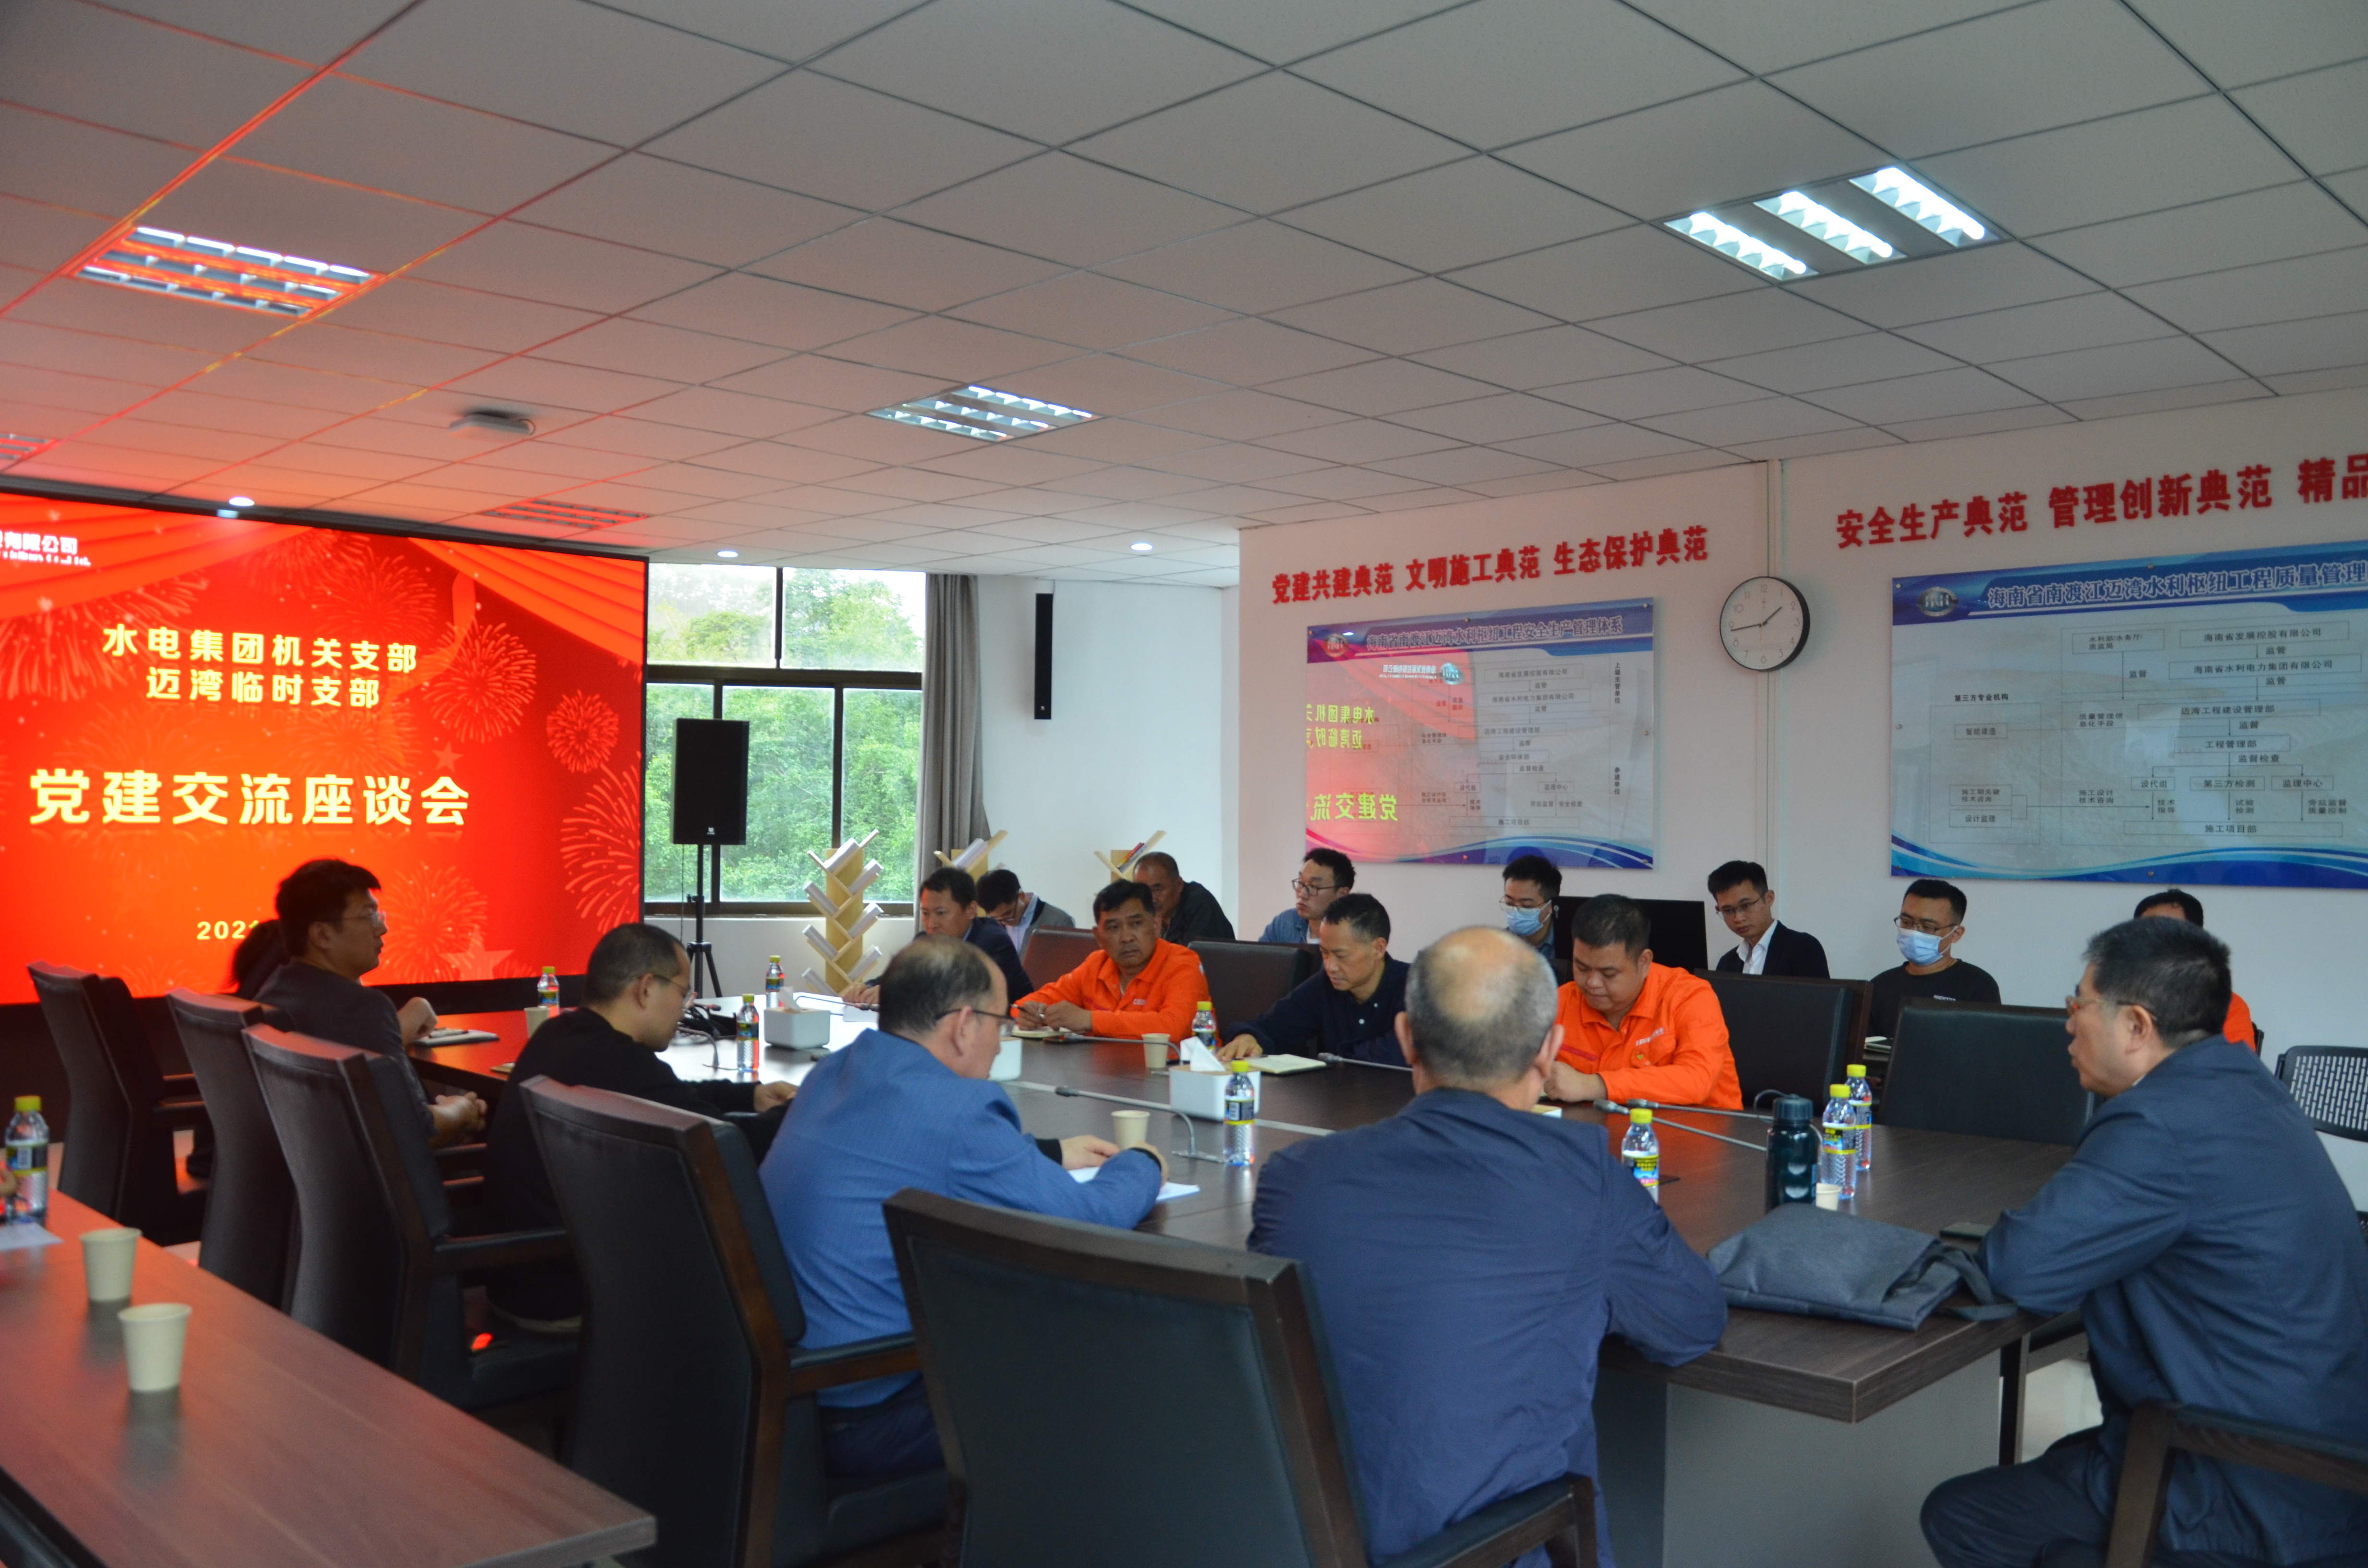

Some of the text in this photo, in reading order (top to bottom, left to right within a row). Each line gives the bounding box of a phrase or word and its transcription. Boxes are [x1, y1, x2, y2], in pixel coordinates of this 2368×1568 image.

[1837, 453, 2368, 549] 安全生产典范 管理创新典范 精品
[0, 530, 78, 555] 有限公司
[1272, 525, 1708, 604] 党建共建典范 文明施工典范 生态保护典范
[1761, 584, 1767, 592] 12
[2204, 628, 2321, 642] 海南省发展控股有限公司
[103, 624, 416, 673] 水电集团机关支部
[2194, 660, 2333, 674] 海南省水利电力集团有限公司
[147, 667, 379, 709] 迈湾临时支部
[2181, 705, 2275, 715] 迈湾工程建设管理部
[2205, 740, 2257, 748] 工程管理部
[30, 768, 469, 825] 党建交流座谈会
